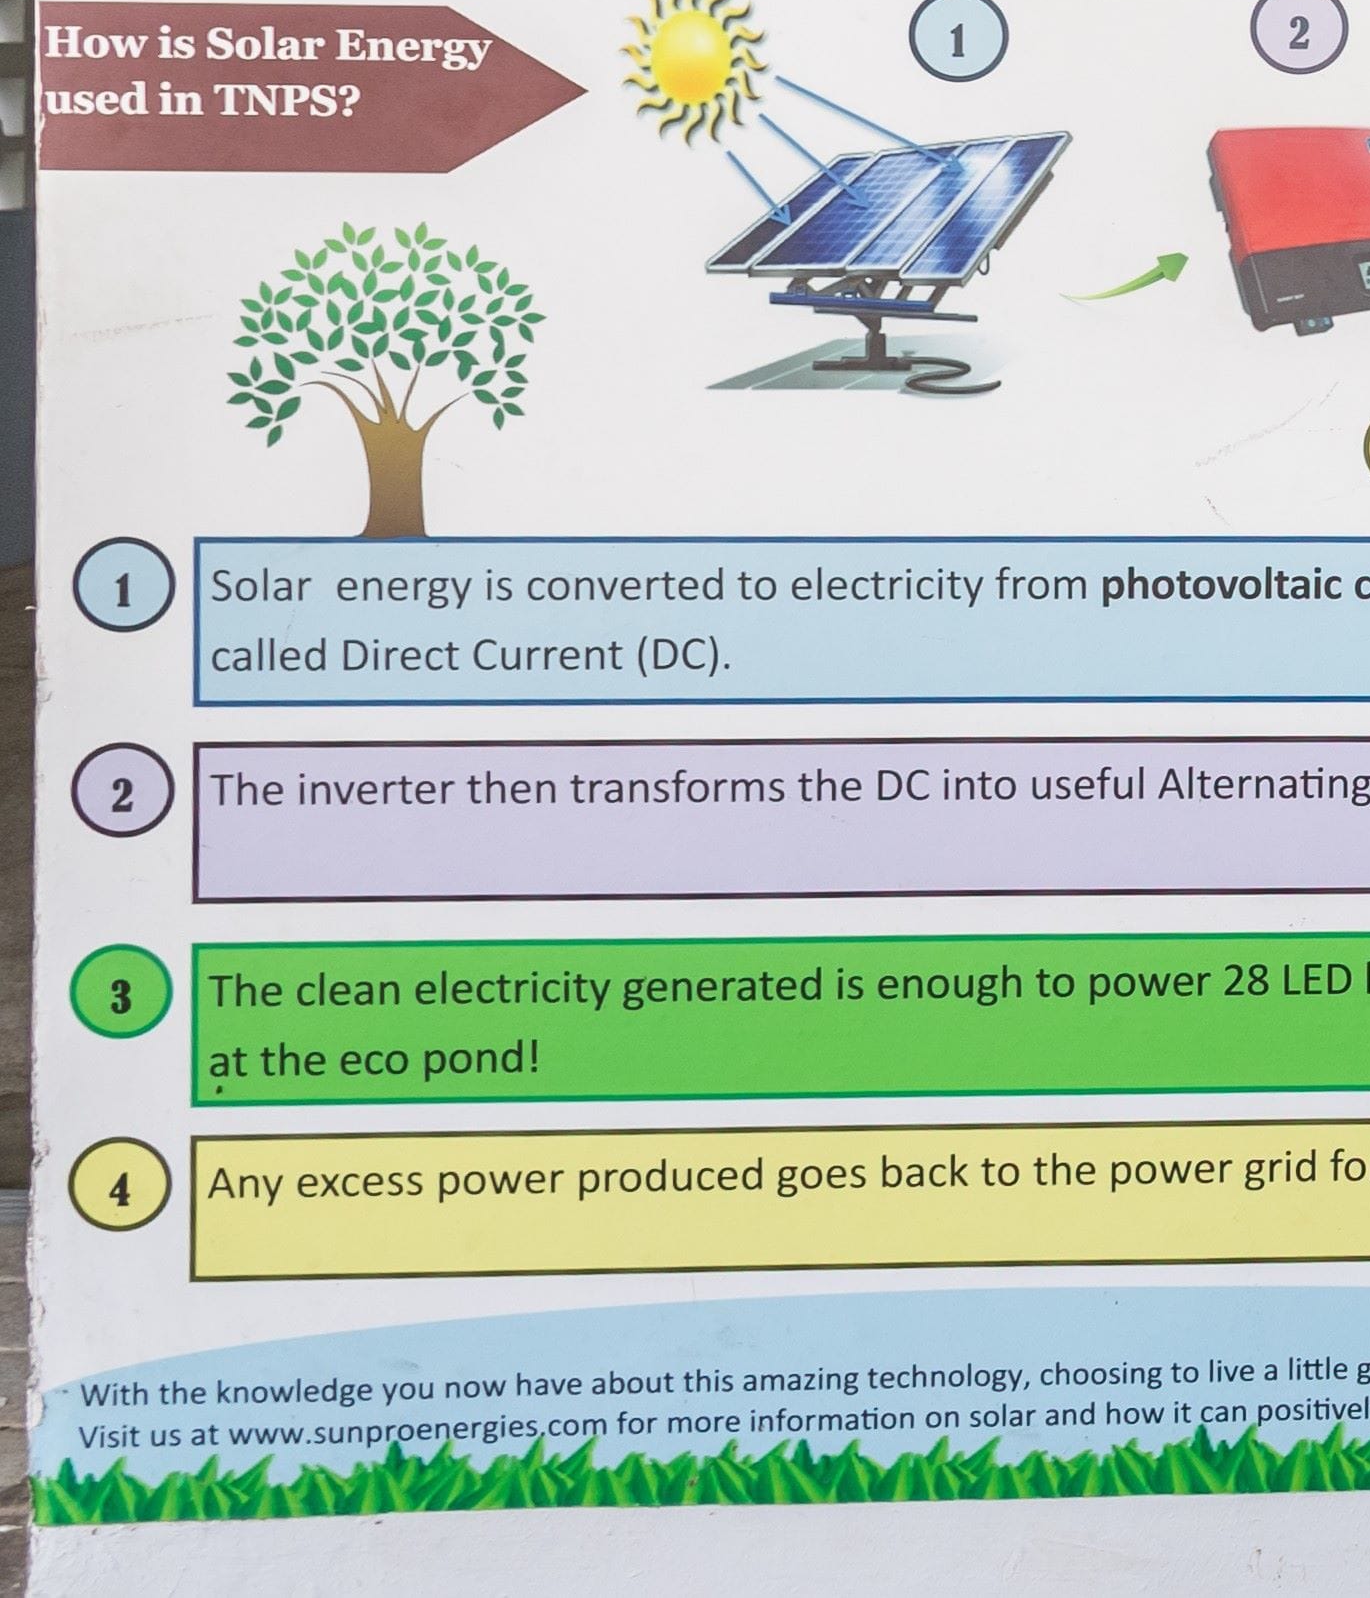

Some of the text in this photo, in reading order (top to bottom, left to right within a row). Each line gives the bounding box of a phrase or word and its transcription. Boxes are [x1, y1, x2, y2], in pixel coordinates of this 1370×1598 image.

[45, 26, 492, 70] How is Solar Energy
[949, 22, 966, 58] 1
[1289, 15, 1310, 51] 2
[44, 82, 360, 118] used in TNPS?
[114, 572, 132, 609] 1
[212, 568, 311, 601] Solar
[337, 578, 472, 609] energy
[487, 569, 512, 601] is
[528, 567, 723, 600] converted
[738, 572, 776, 600] to
[792, 567, 983, 607] electricity
[996, 567, 1086, 599] from
[1103, 567, 1341, 607] photovoltaic
[212, 636, 729, 677] called Direct Current (DC).
[111, 776, 135, 813] 2
[210, 772, 283, 805] The
[300, 774, 455, 805] inverter
[467, 771, 555, 804] then
[570, 770, 784, 803] transforms
[798, 769, 861, 801] the
[878, 770, 929, 800] DC
[944, 769, 1016, 800] into
[1033, 767, 1144, 799] useful
[110, 979, 132, 1016] 3
[108, 1172, 131, 1208] 4
[81, 1382, 148, 1406] With
[160, 1381, 206, 1405] the
[218, 1378, 372, 1407] knowledge
[383, 1383, 433, 1406] you
[446, 1380, 506, 1398] now
[517, 1373, 582, 1395] have
[592, 1371, 674, 1395] about
[684, 1369, 733, 1392] this
[744, 1368, 858, 1395] amazing
[868, 1363, 1029, 1392] technology,
[1041, 1362, 1162, 1389] choosing
[1171, 1363, 1198, 1383] to
[1210, 1359, 1254, 1382] live
[1265, 1364, 1277, 1380] a
[1289, 1357, 1347, 1380] little
